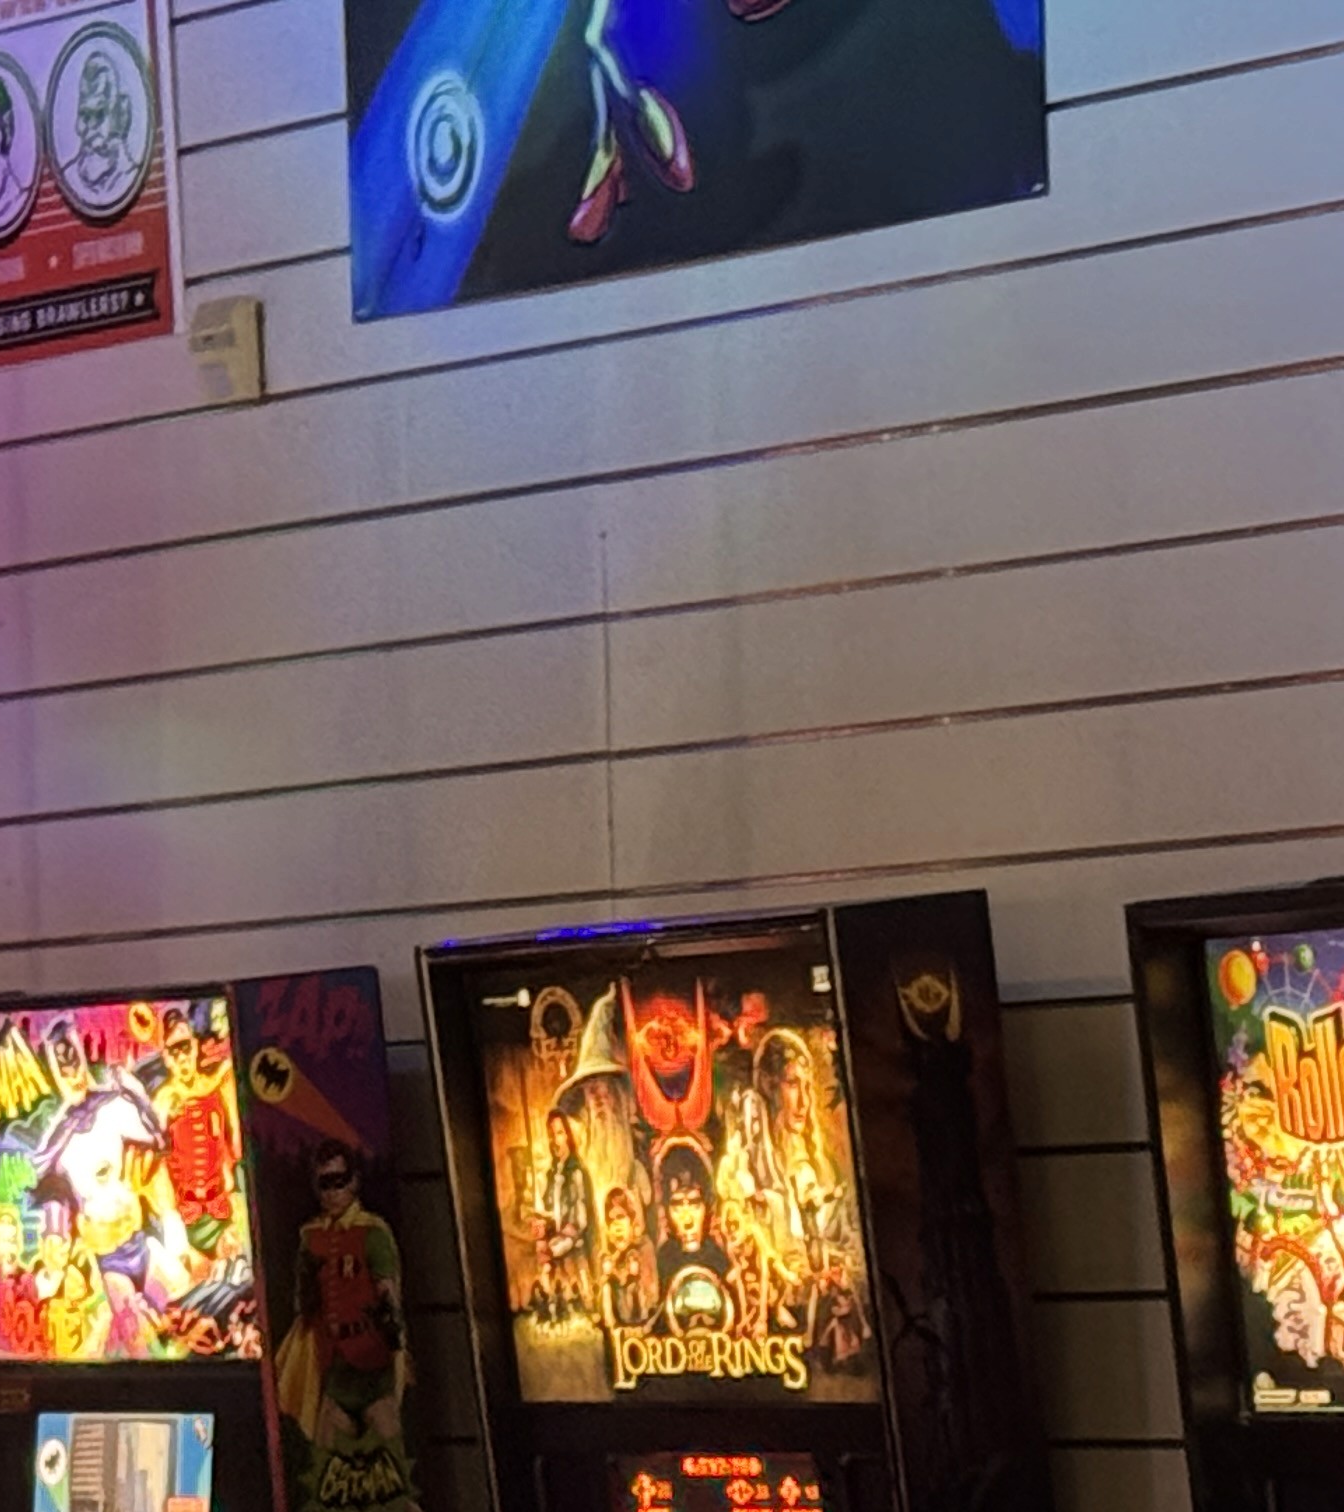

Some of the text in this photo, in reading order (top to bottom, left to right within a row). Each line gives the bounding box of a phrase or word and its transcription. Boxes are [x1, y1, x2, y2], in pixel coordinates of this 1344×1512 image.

[613, 1328, 687, 1389] LORD
[709, 1331, 808, 1390] RINGS
[319, 1450, 405, 1505] BATMAN
